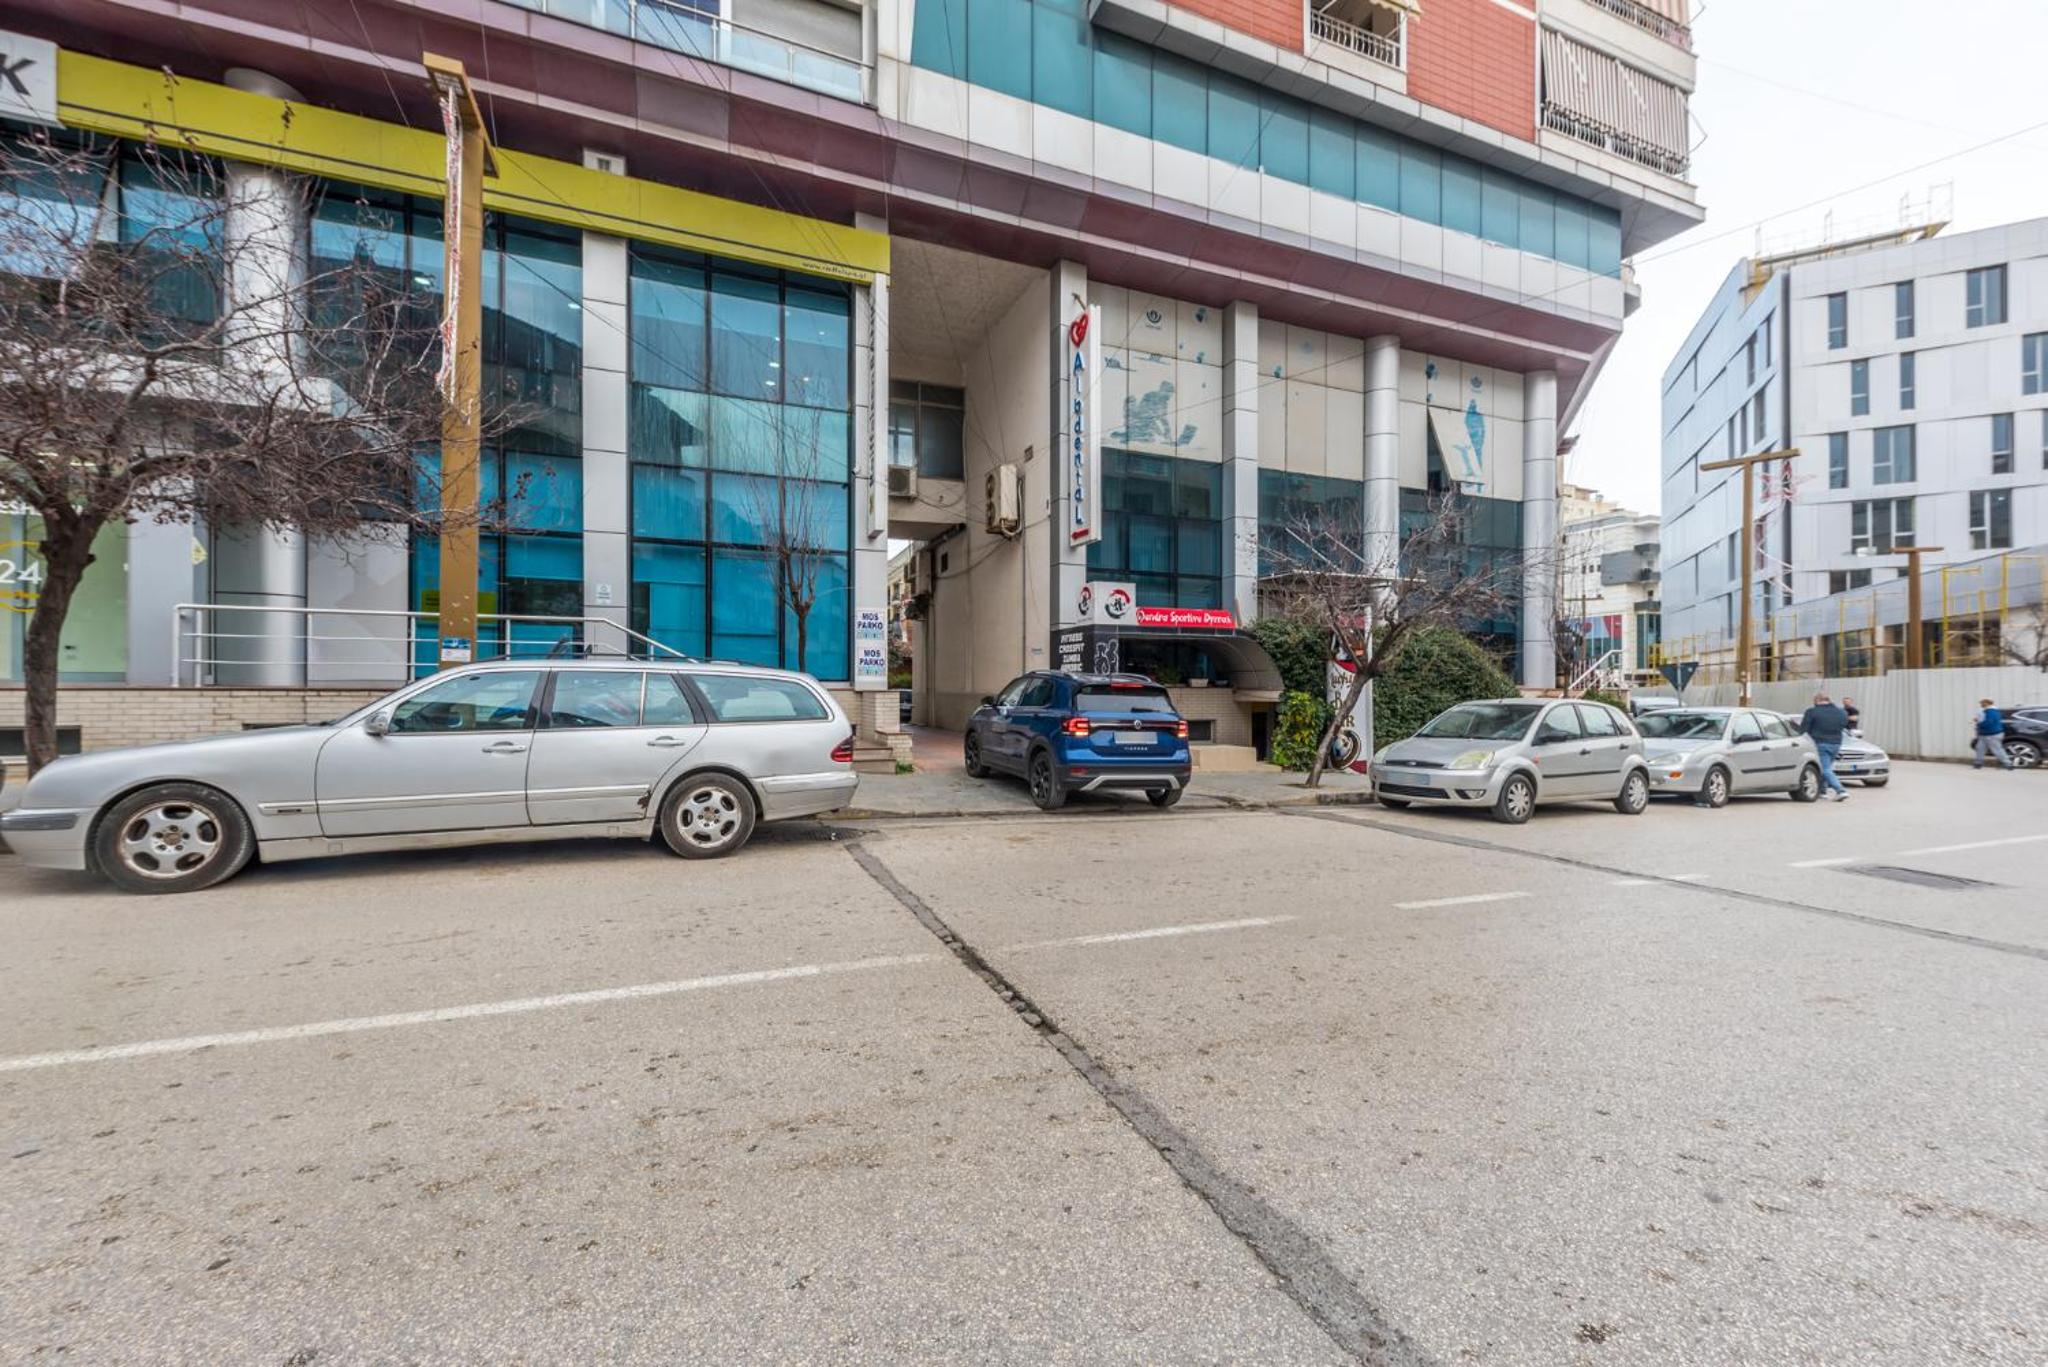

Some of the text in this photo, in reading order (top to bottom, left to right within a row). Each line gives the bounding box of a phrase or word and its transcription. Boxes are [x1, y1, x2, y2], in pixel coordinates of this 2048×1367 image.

[862, 612, 879, 621] MOS
[857, 622, 883, 630] PARKO
[863, 649, 881, 657] MOS
[859, 659, 884, 667] PARKO
